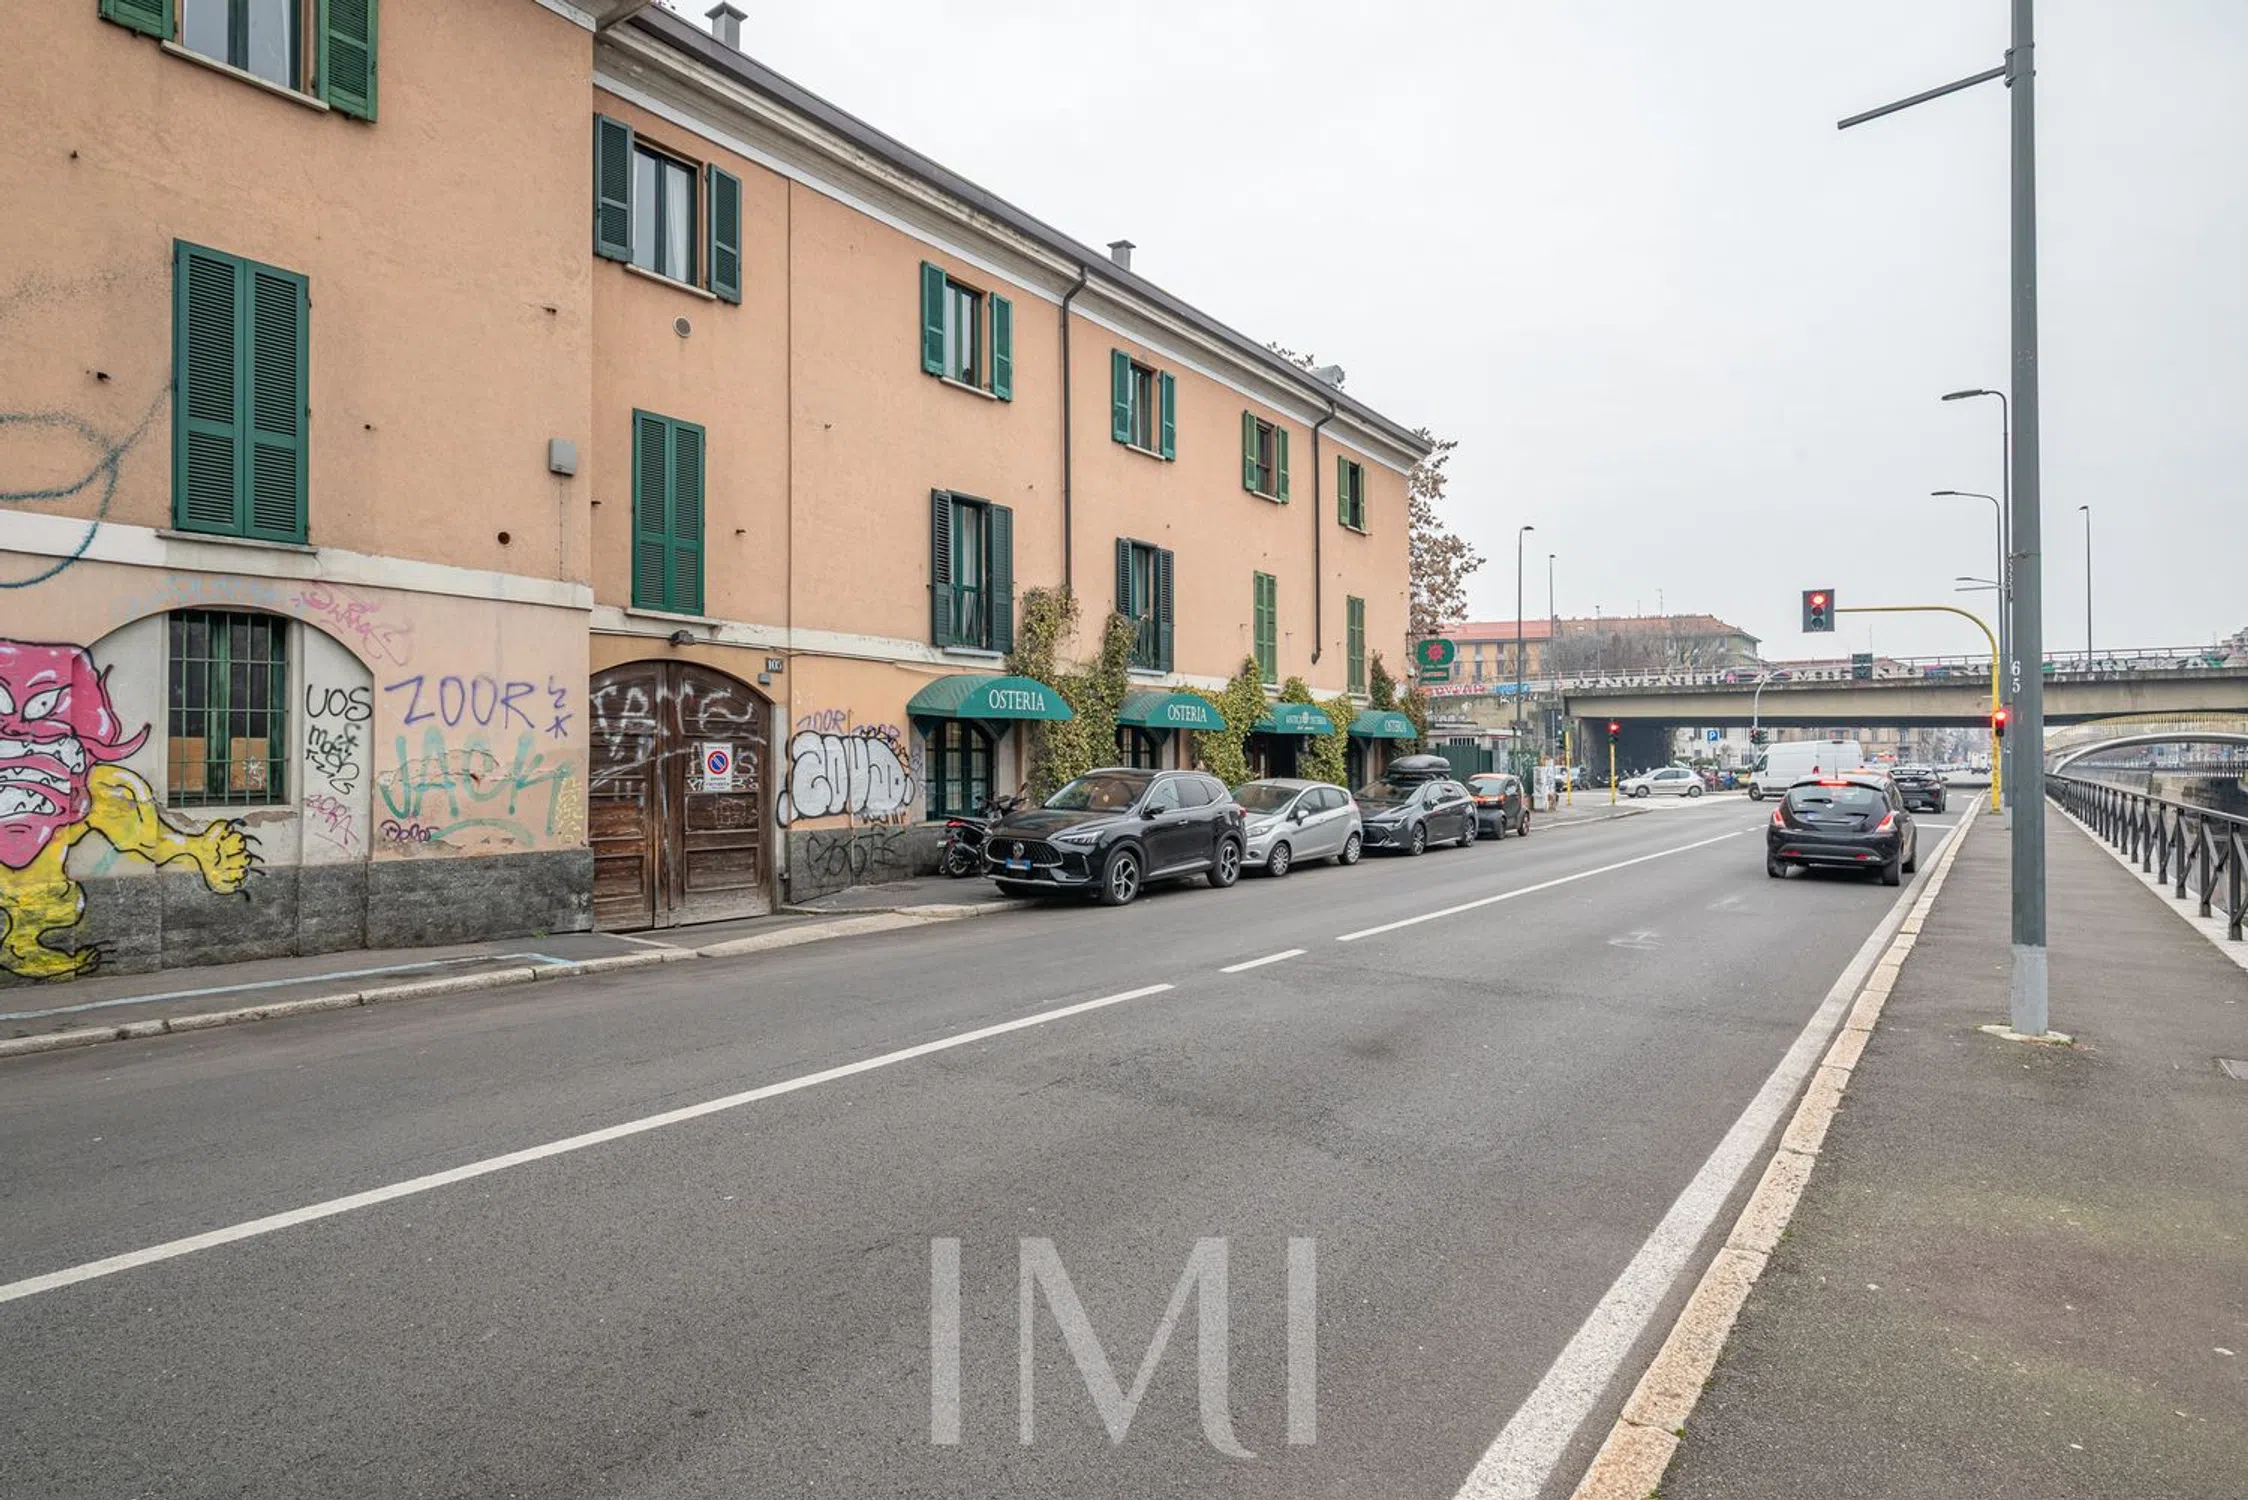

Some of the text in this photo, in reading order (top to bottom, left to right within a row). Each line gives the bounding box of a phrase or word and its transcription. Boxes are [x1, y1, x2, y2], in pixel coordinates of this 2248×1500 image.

[306, 684, 372, 721] UOS
[384, 675, 536, 729] ZOOR
[989, 689, 1046, 711] OSTERIA
[1167, 704, 1207, 722] OSTERIA
